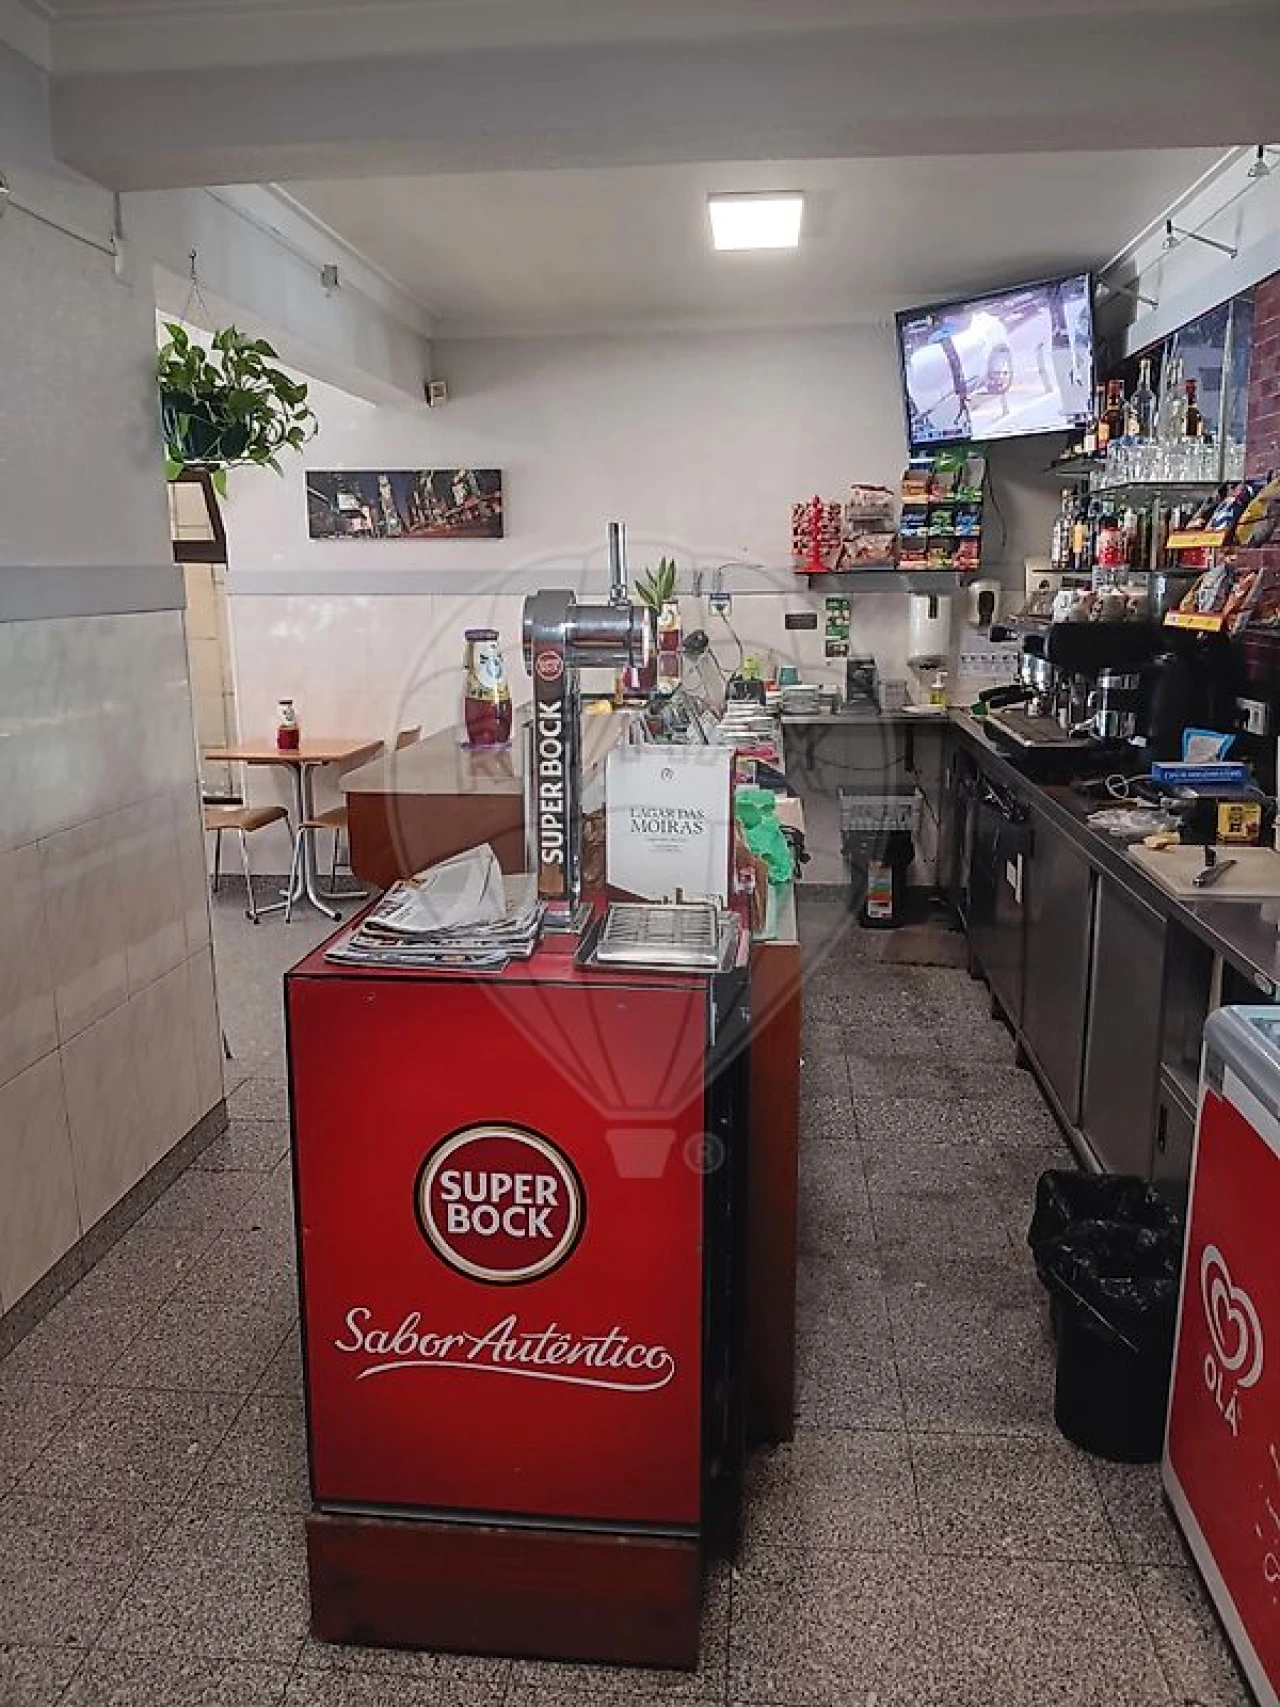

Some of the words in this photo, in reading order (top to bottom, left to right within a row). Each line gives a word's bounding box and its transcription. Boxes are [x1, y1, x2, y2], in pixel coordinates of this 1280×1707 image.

[539, 701, 563, 778] BOCK
[541, 779, 564, 865] SUPER
[630, 807, 674, 818] LAGAR
[678, 808, 705, 819] DAS
[630, 819, 704, 835] MOIRAS
[440, 1170, 559, 1207] SUPER
[447, 1205, 554, 1239] BOCK
[335, 1306, 465, 1358] Sabor
[465, 1313, 673, 1372] Autêntico
[1204, 1354, 1241, 1437] OLÁ
